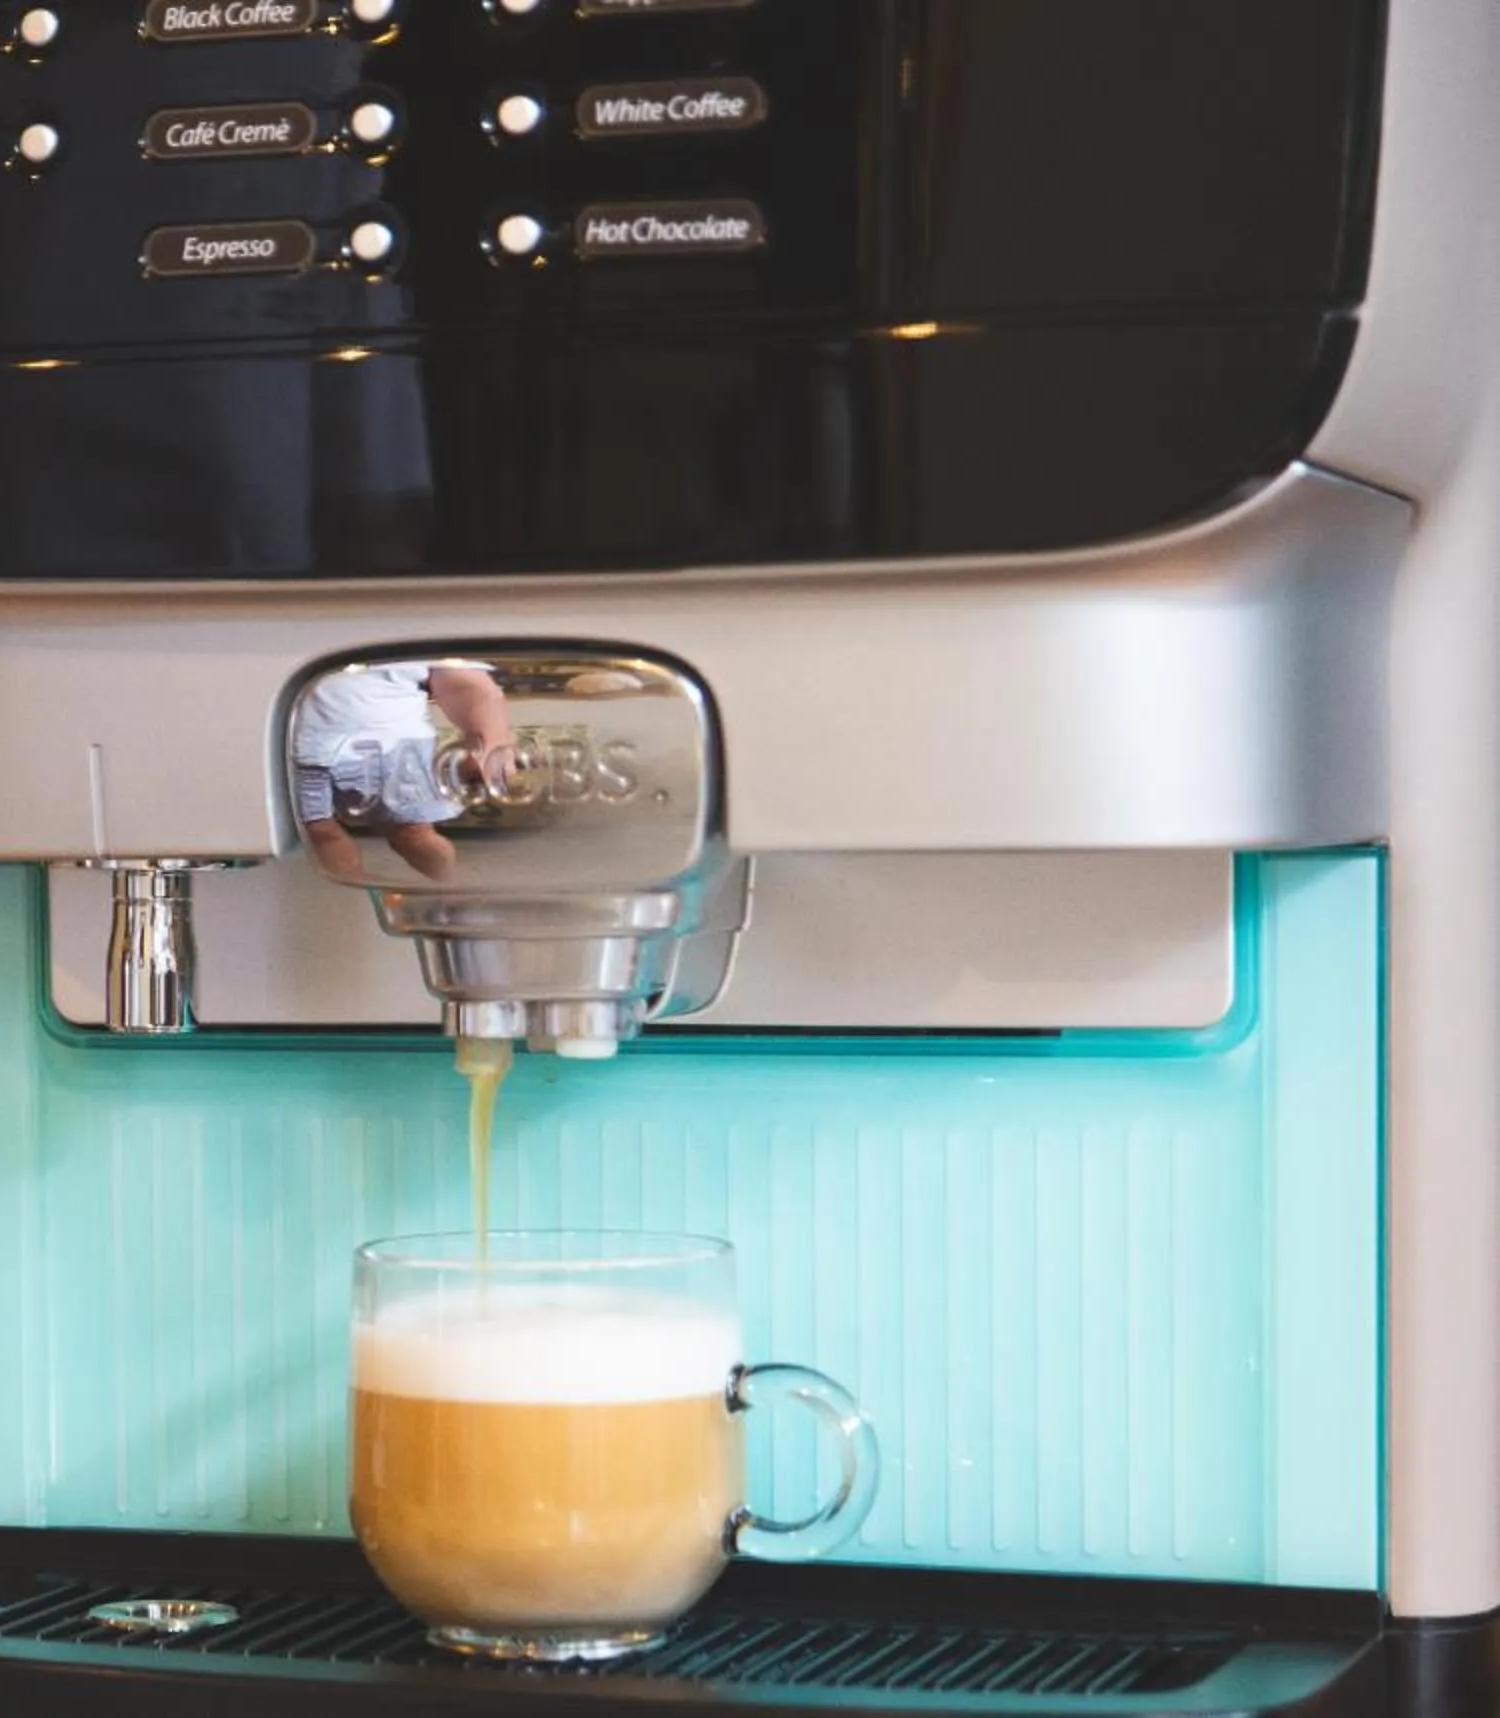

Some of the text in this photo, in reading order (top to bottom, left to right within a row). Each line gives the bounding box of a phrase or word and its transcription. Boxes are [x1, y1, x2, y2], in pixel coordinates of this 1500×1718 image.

[163, 0, 296, 31] Black Coffee
[595, 91, 746, 126] White Coffee
[165, 121, 216, 147] Café
[585, 214, 751, 243] Hot Chocolate
[182, 236, 276, 265] Espresso
